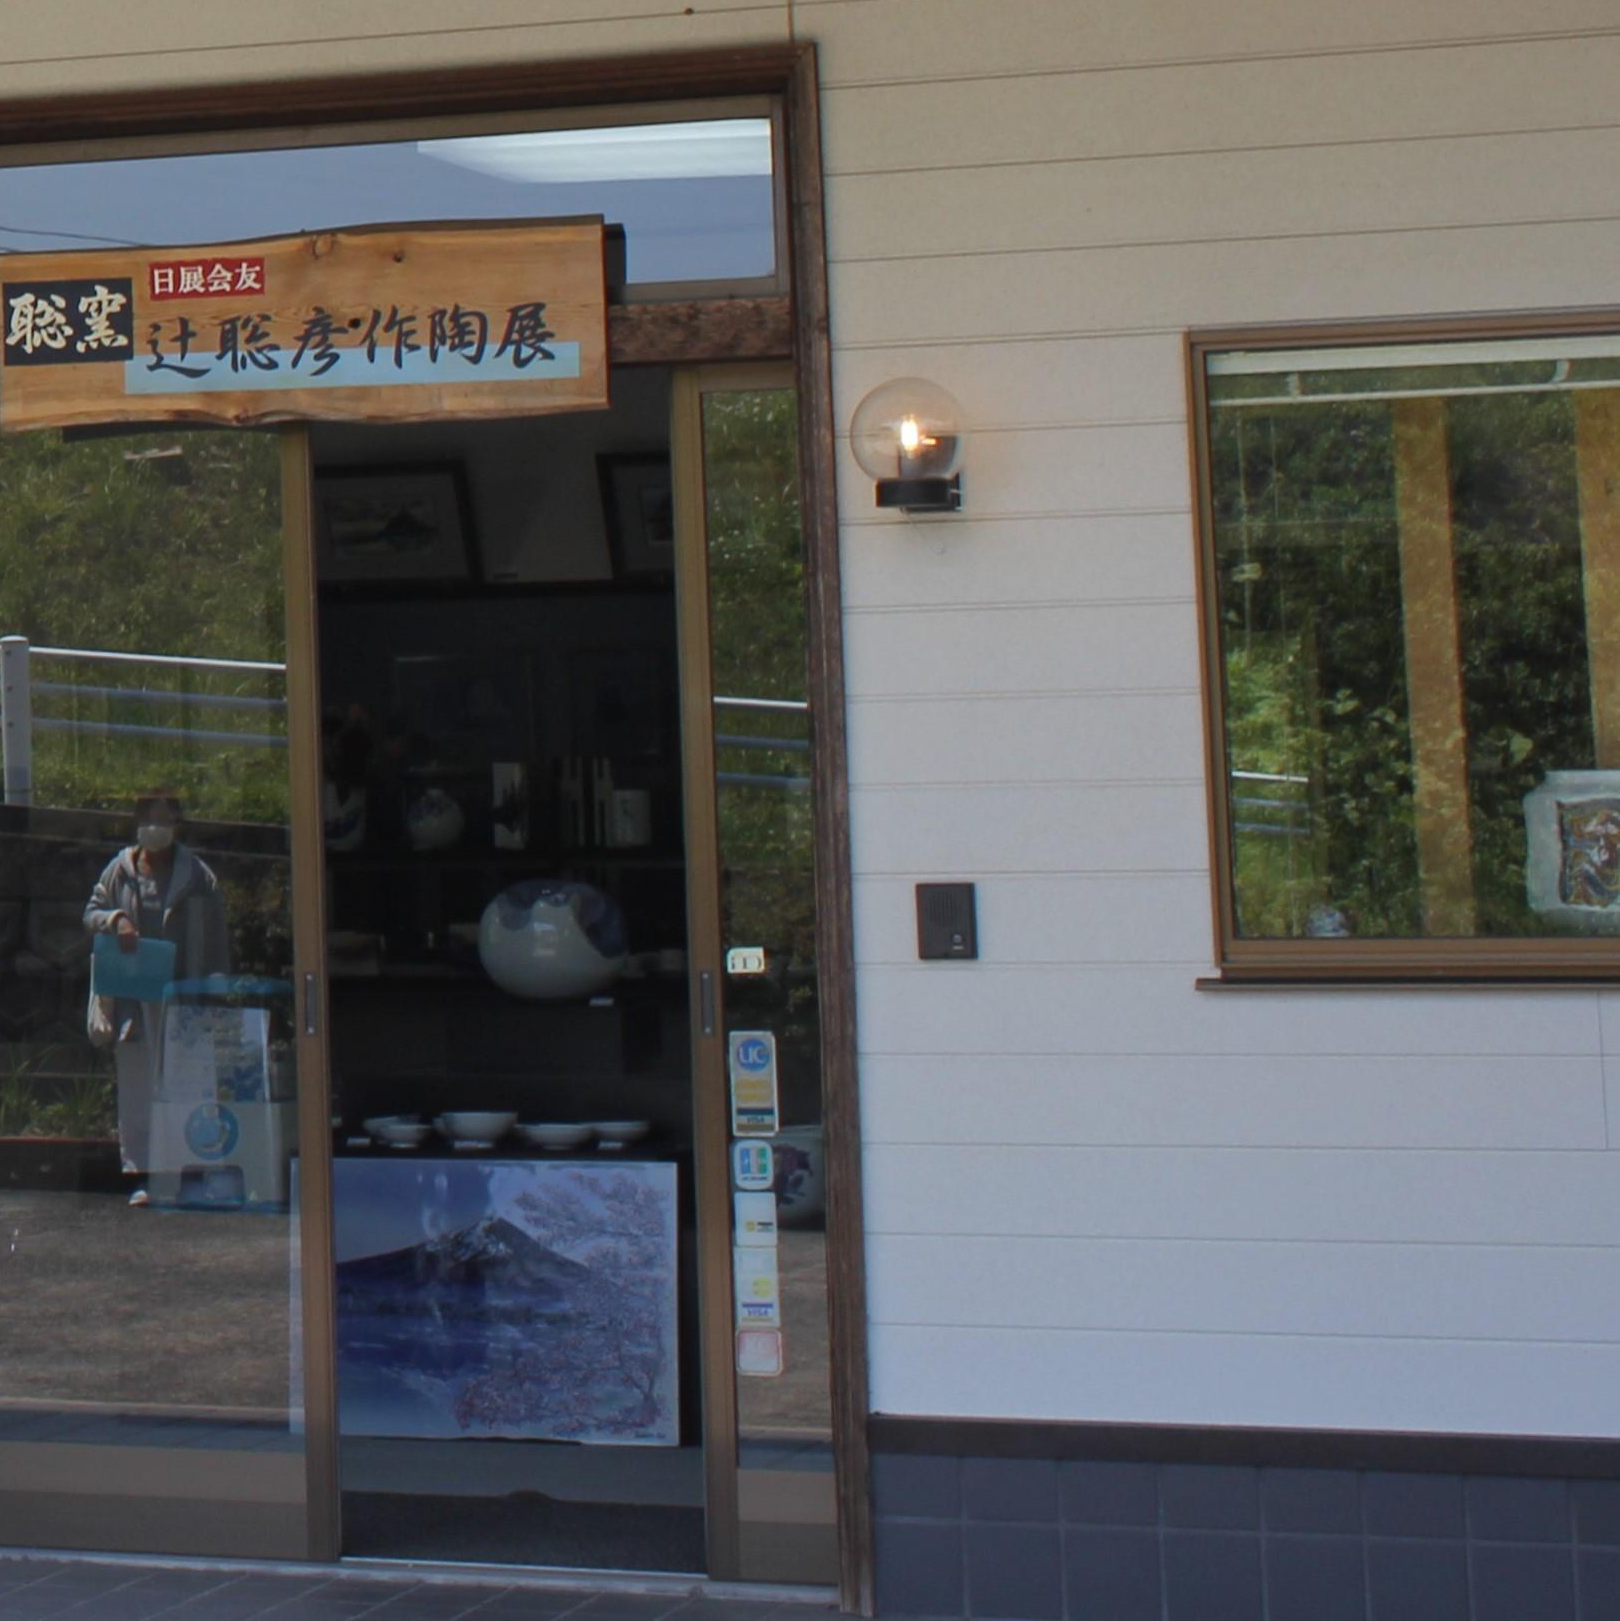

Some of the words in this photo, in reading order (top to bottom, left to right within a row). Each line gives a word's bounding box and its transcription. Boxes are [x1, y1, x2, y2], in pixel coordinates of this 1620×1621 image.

[153, 262, 262, 295] 日展会友
[6, 285, 129, 354] 聡窯
[145, 302, 556, 379] 辻聡彦作陶展
[738, 1046, 766, 1065] UC
